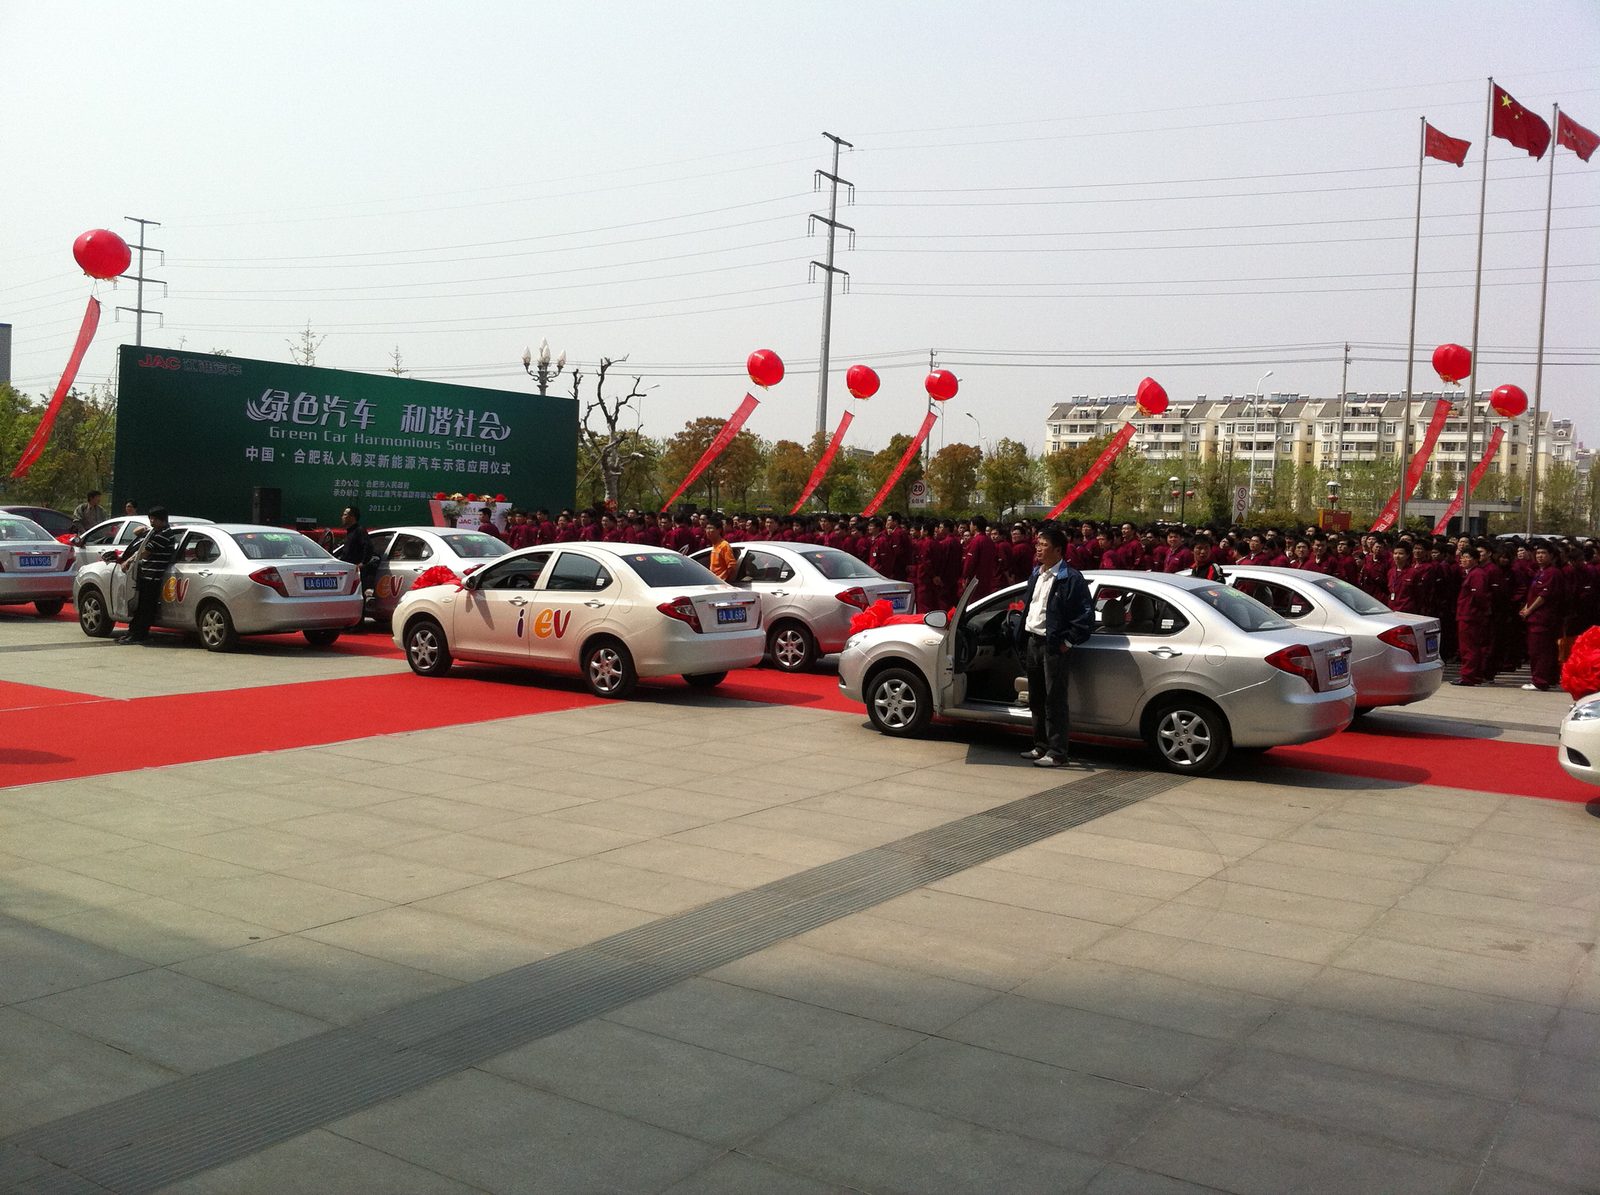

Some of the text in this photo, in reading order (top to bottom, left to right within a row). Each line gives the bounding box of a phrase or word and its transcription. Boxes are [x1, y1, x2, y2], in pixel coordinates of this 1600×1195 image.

[138, 354, 181, 370] JAC
[246, 388, 511, 441] 绿色汽车 和谐社会
[269, 426, 496, 456] Green Car Harmonious Society
[913, 484, 923, 492] 20
